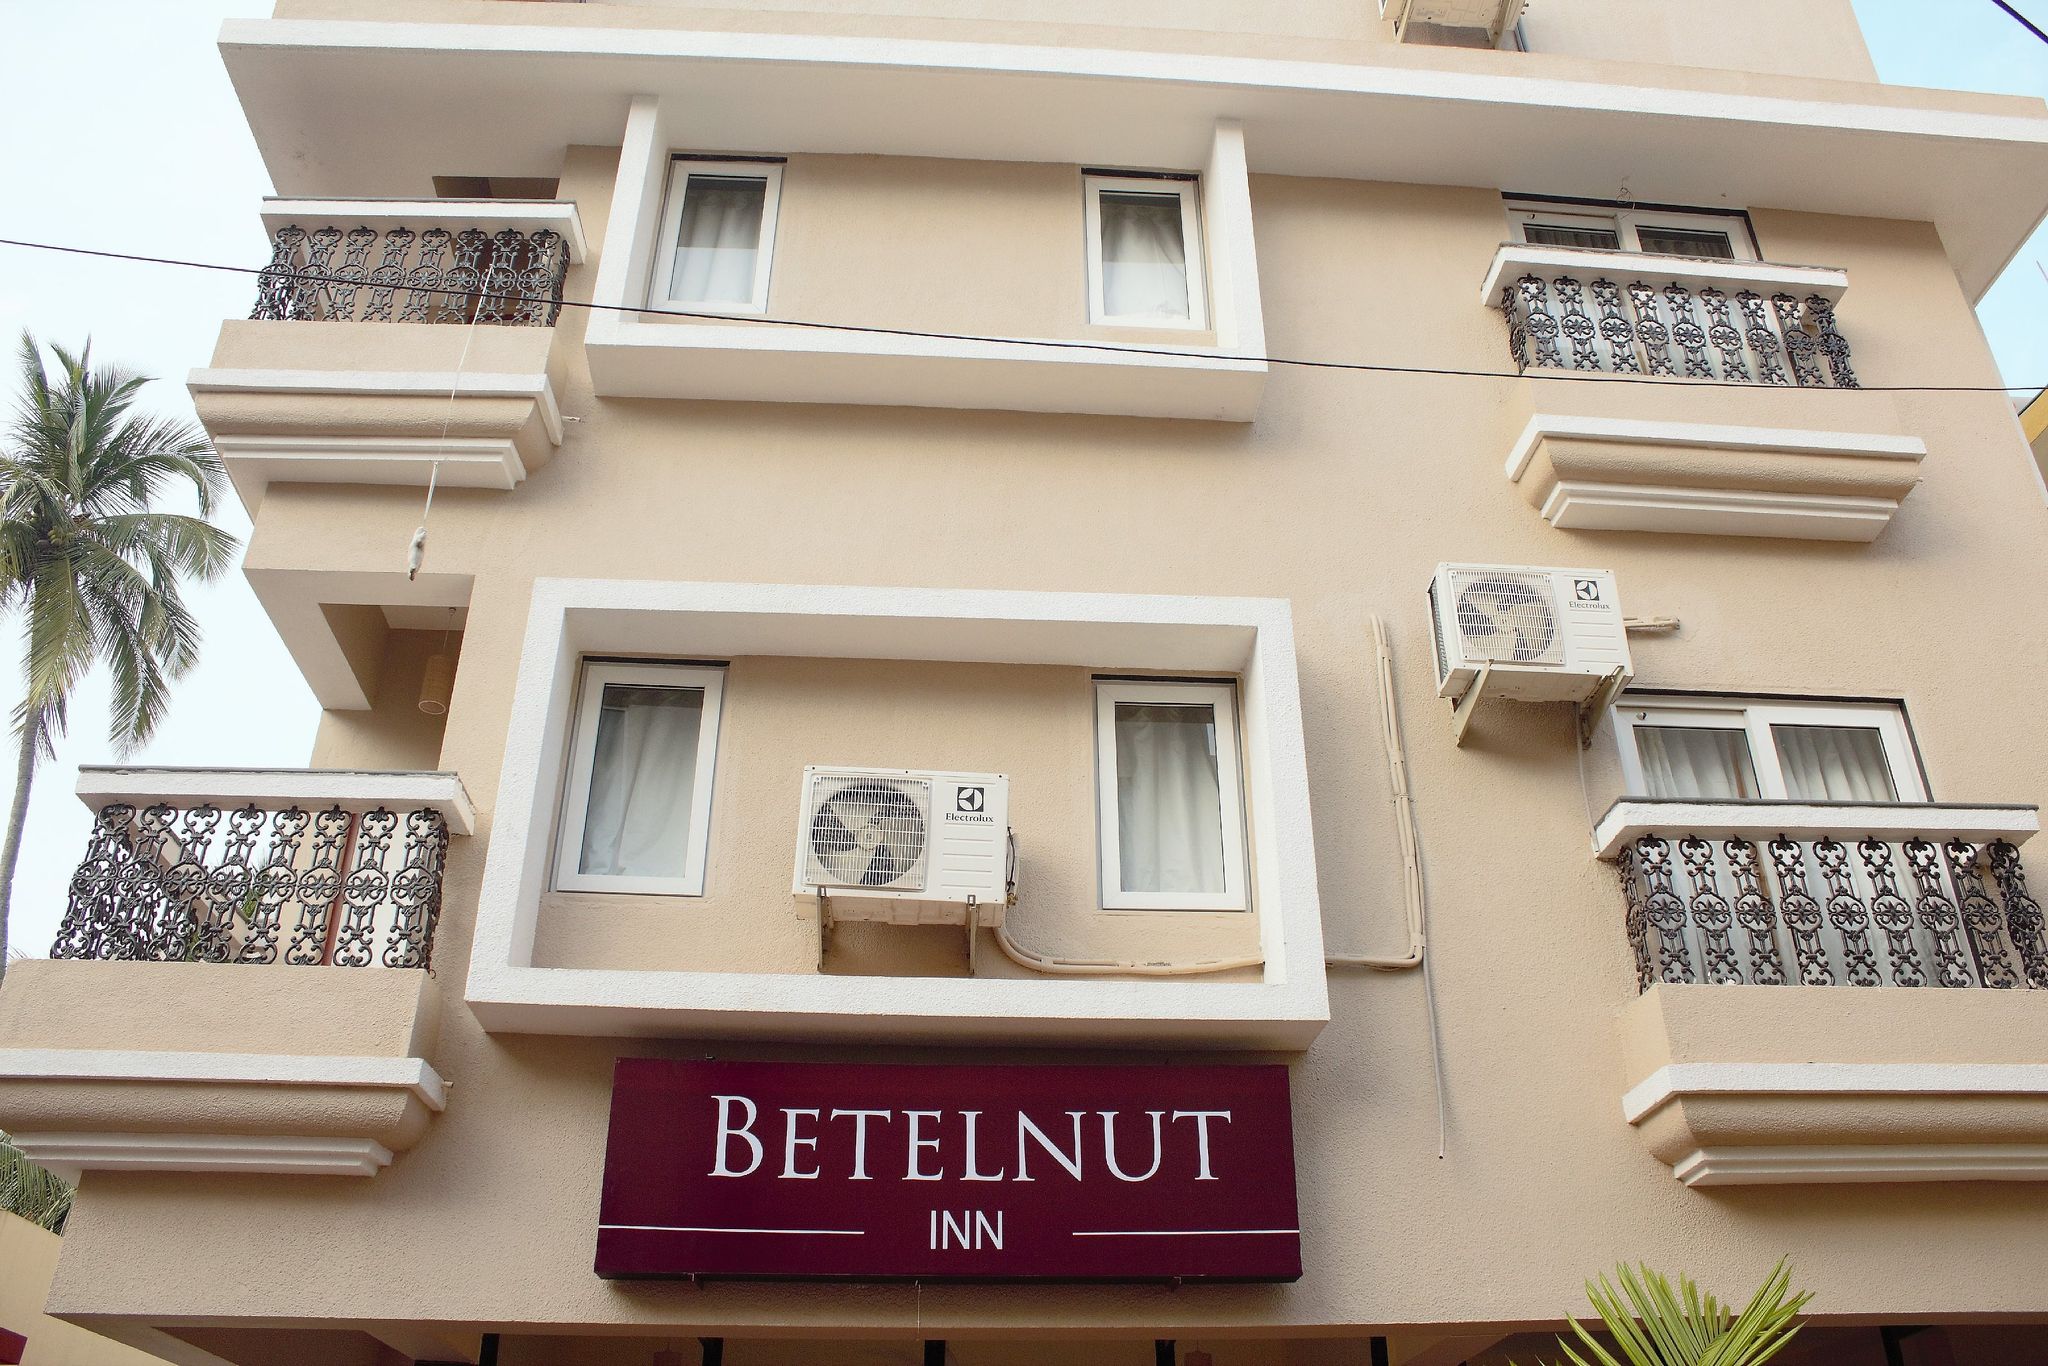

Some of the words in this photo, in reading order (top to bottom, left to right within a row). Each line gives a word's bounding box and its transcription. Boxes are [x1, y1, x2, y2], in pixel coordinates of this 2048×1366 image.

[1569, 601, 1610, 610] Electrolux
[945, 812, 994, 823] Electrolux
[707, 1095, 1232, 1182] BETELNUT
[930, 1210, 1004, 1250] INN
